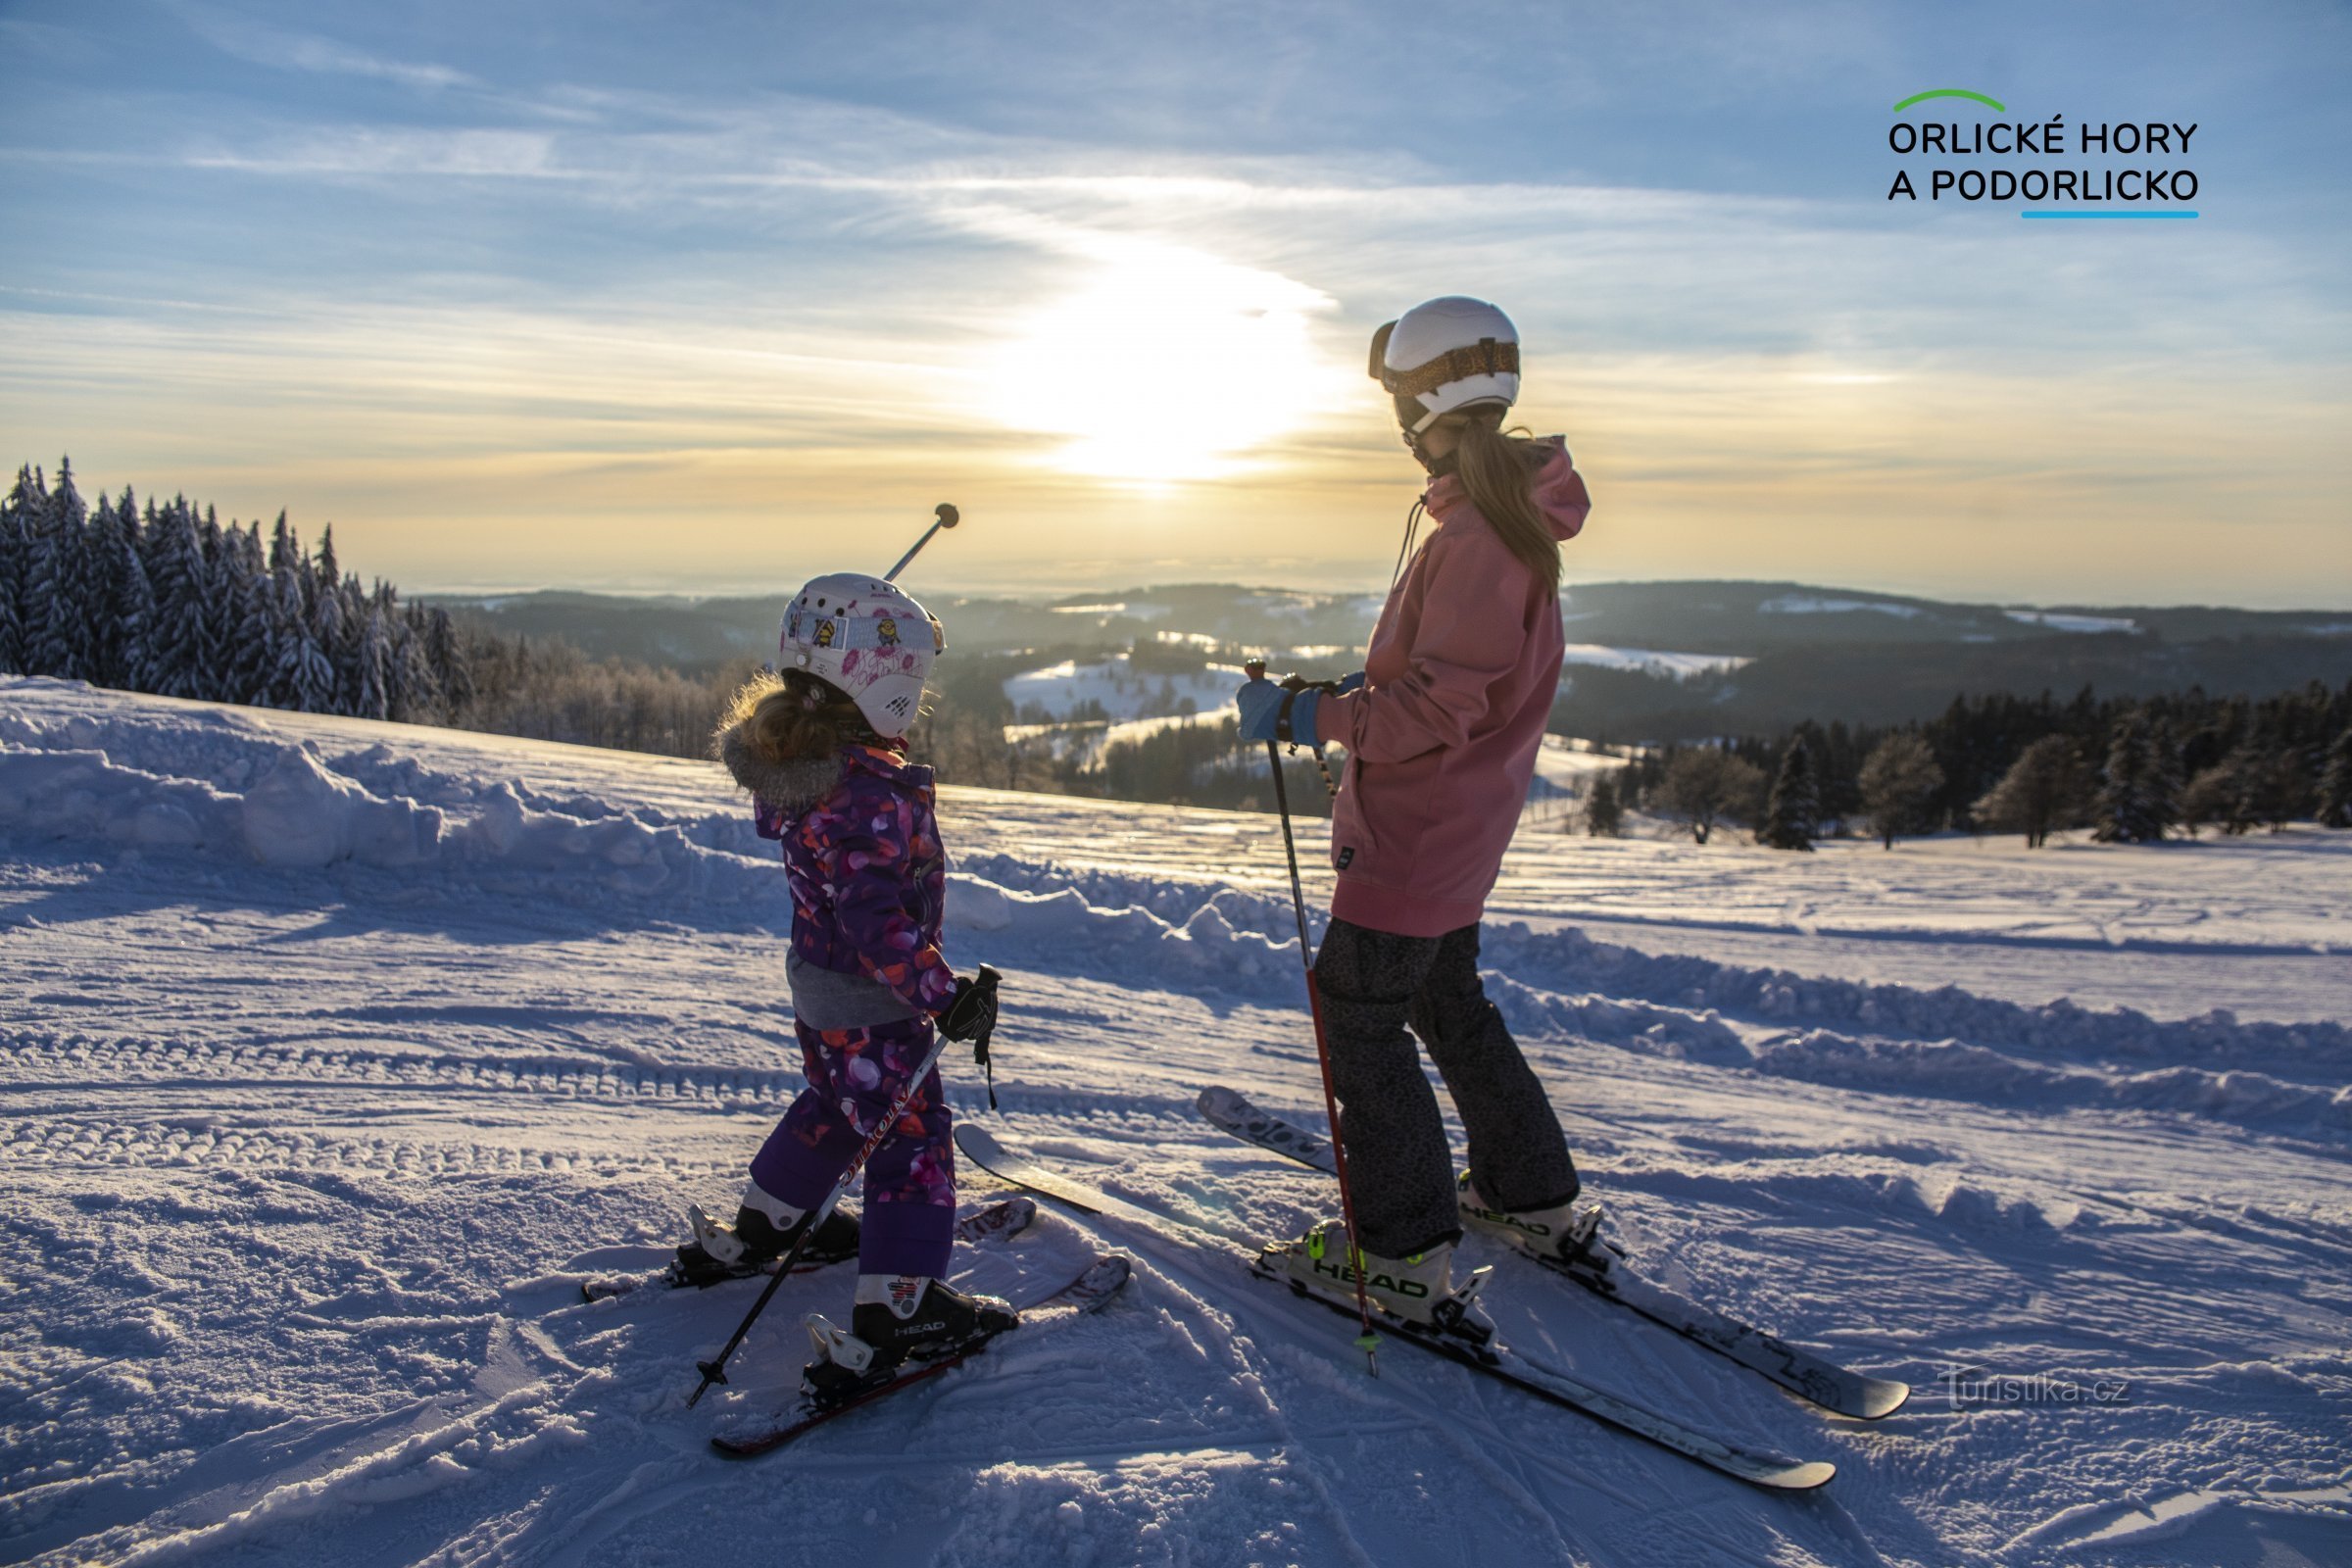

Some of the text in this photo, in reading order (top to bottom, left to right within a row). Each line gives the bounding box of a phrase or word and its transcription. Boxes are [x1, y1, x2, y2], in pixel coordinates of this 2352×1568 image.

[1460, 1201, 1551, 1237] HEAD
[1313, 1258, 1429, 1298] HEAD
[895, 1320, 946, 1337] HEAD
